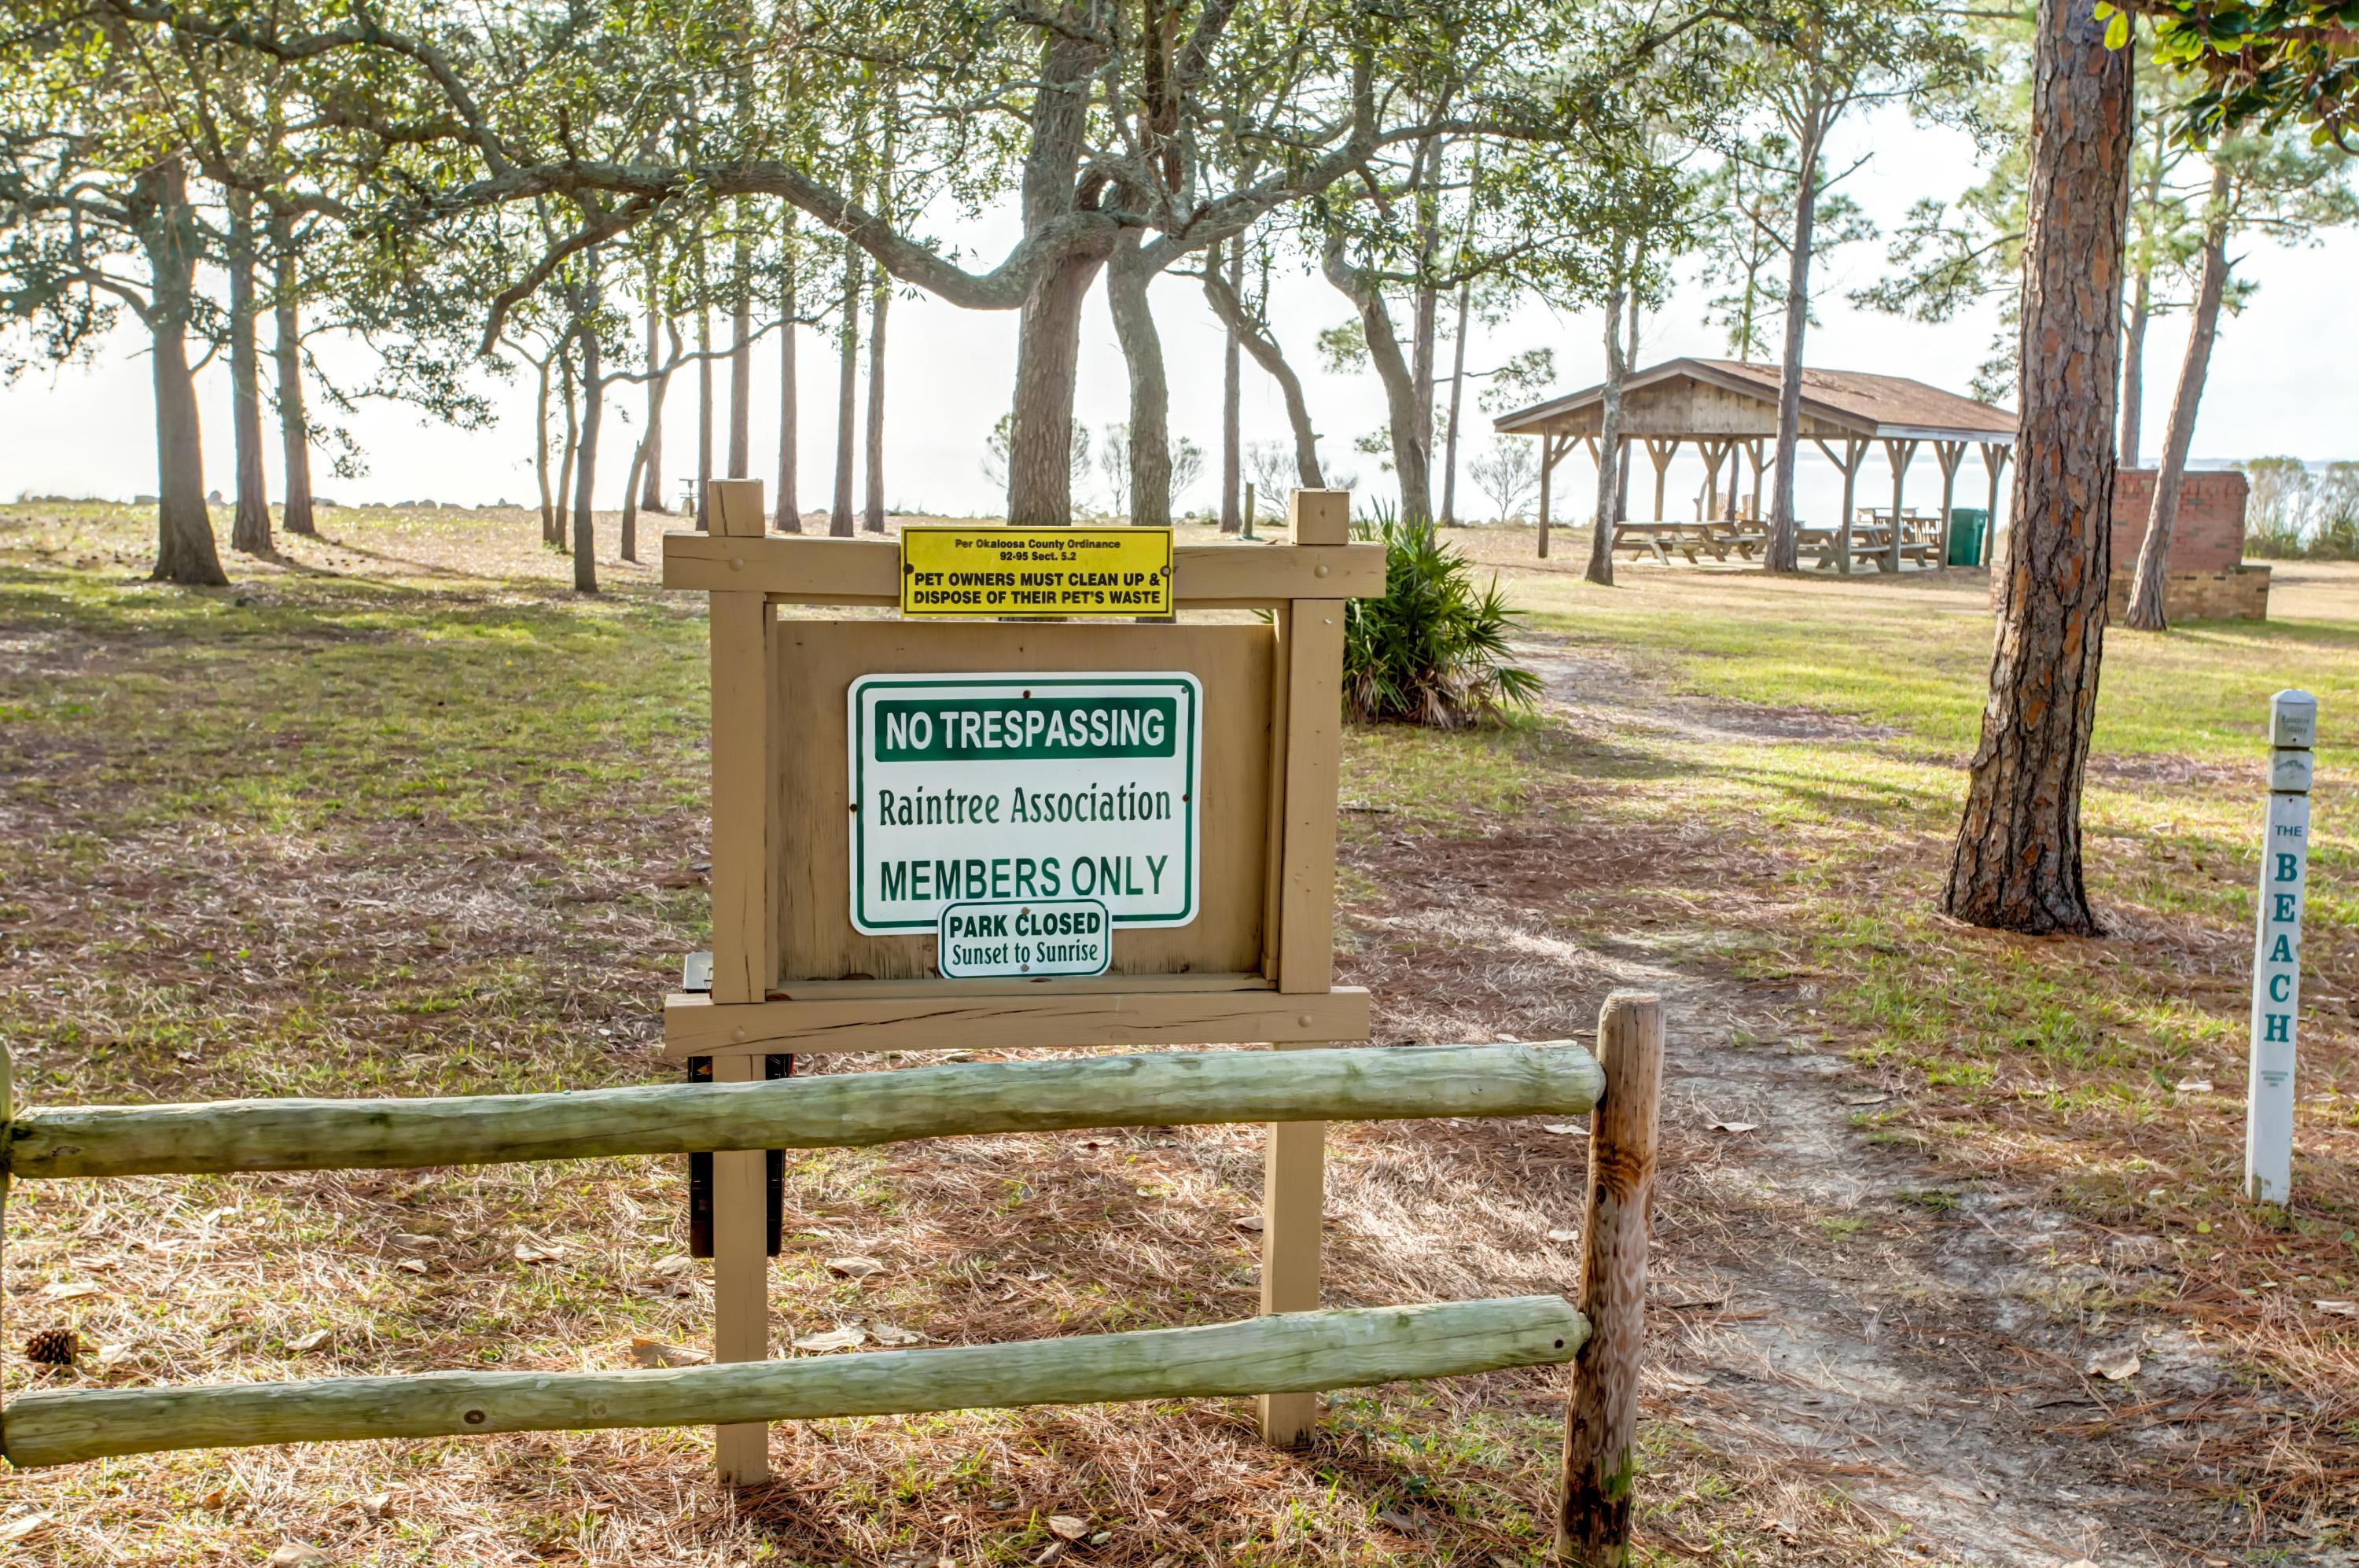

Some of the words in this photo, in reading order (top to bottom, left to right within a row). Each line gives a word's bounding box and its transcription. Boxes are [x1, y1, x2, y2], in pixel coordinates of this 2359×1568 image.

[955, 539, 973, 549] Per
[976, 539, 1025, 549] Okaloosa
[1029, 539, 1065, 550] County
[1067, 539, 1121, 549] Ordinance
[999, 551, 1029, 561] 92-95
[1031, 551, 1058, 561] Sect.
[915, 572, 944, 586] PET
[948, 572, 1015, 586] OWNERS
[1020, 572, 1064, 586] MUST
[1068, 572, 1118, 586] CLEAN
[1123, 572, 1145, 586] UP
[1149, 572, 1160, 586] &
[914, 591, 982, 604] DISPOSE
[986, 591, 1007, 604] OF
[1010, 591, 1057, 604] THEIR
[1062, 591, 1105, 604] PET'S
[1110, 591, 1161, 604] WASTE
[885, 711, 933, 749] NO
[940, 708, 1165, 749] TRESPASSING
[878, 786, 1000, 826] Raintree
[1010, 782, 1172, 823] Association
[2275, 825, 2302, 837] THE
[881, 857, 1061, 901] MEMBERS
[1072, 855, 1168, 896] ONLY
[949, 915, 1008, 938] PARK
[1015, 912, 1101, 937] CLOSED
[952, 943, 1009, 965] Sunset
[1014, 943, 1031, 963] to
[1036, 939, 1098, 963] Sunrise
[2264, 853, 2298, 1042] BEACH
